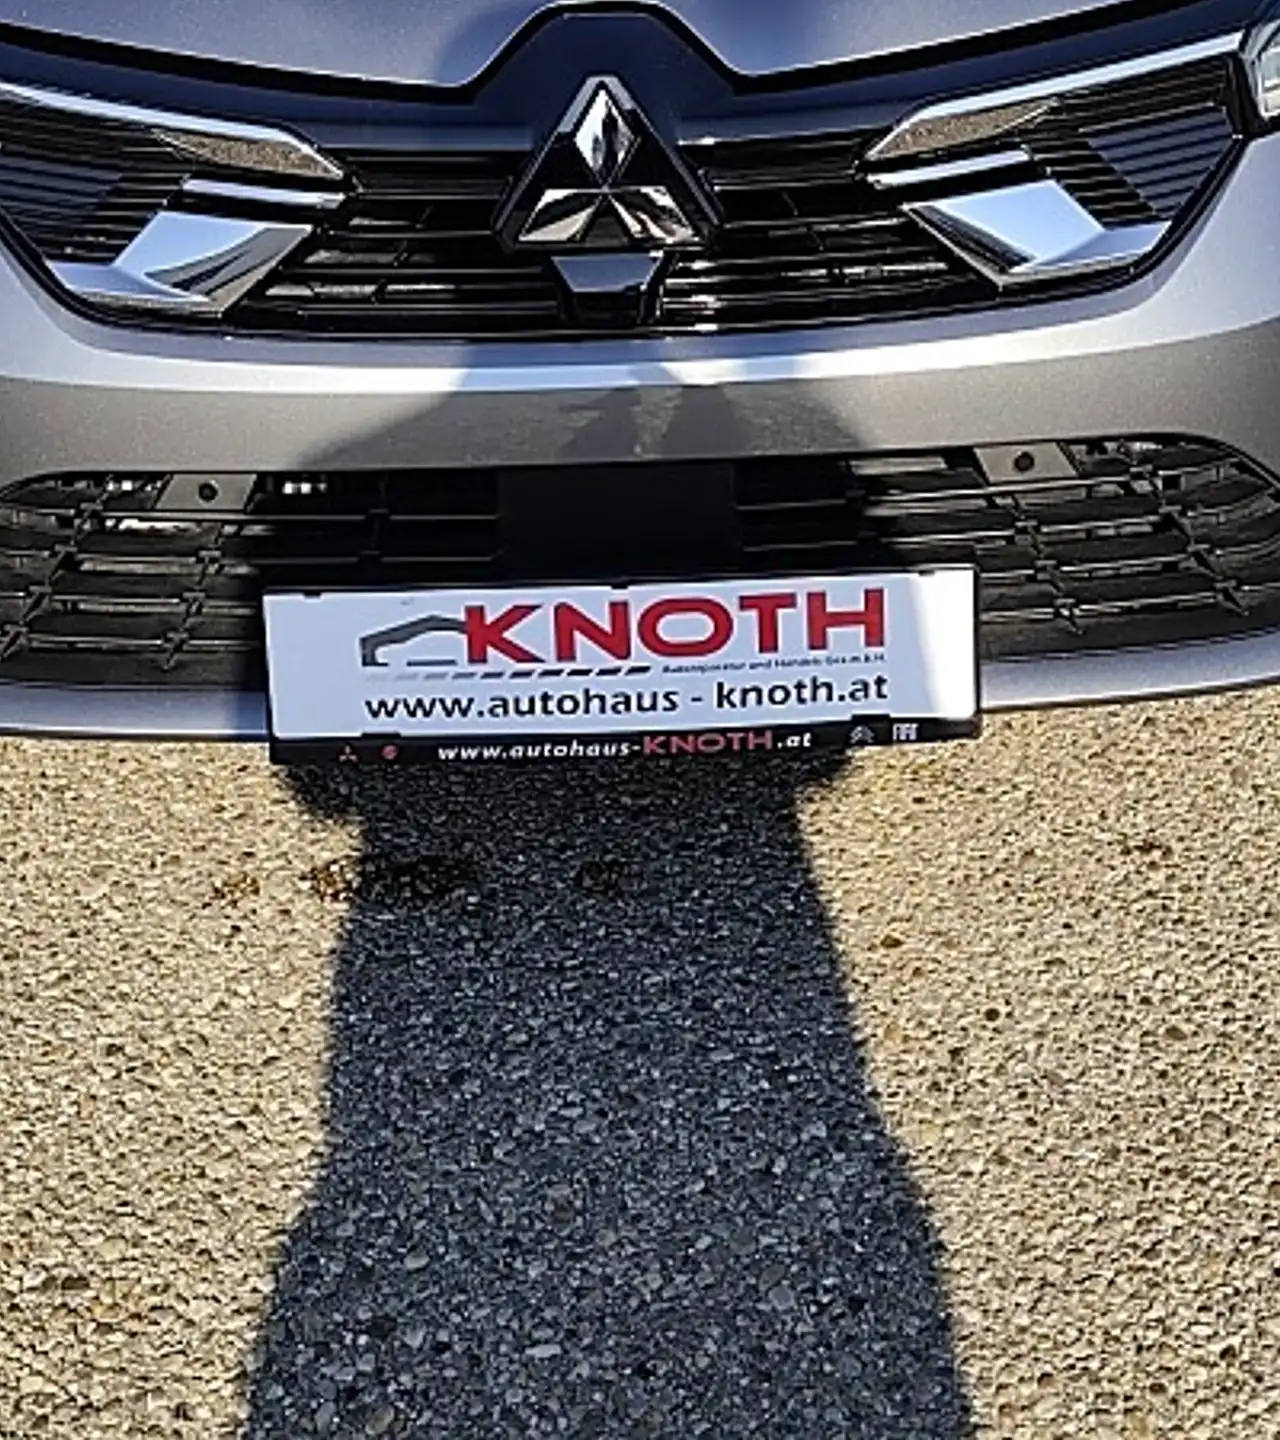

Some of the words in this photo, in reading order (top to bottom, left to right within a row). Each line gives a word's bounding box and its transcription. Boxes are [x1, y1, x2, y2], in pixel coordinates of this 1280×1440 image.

[464, 587, 885, 664] KNOTH
[365, 687, 679, 719] www.autohaus
[715, 674, 889, 709] knoth.at
